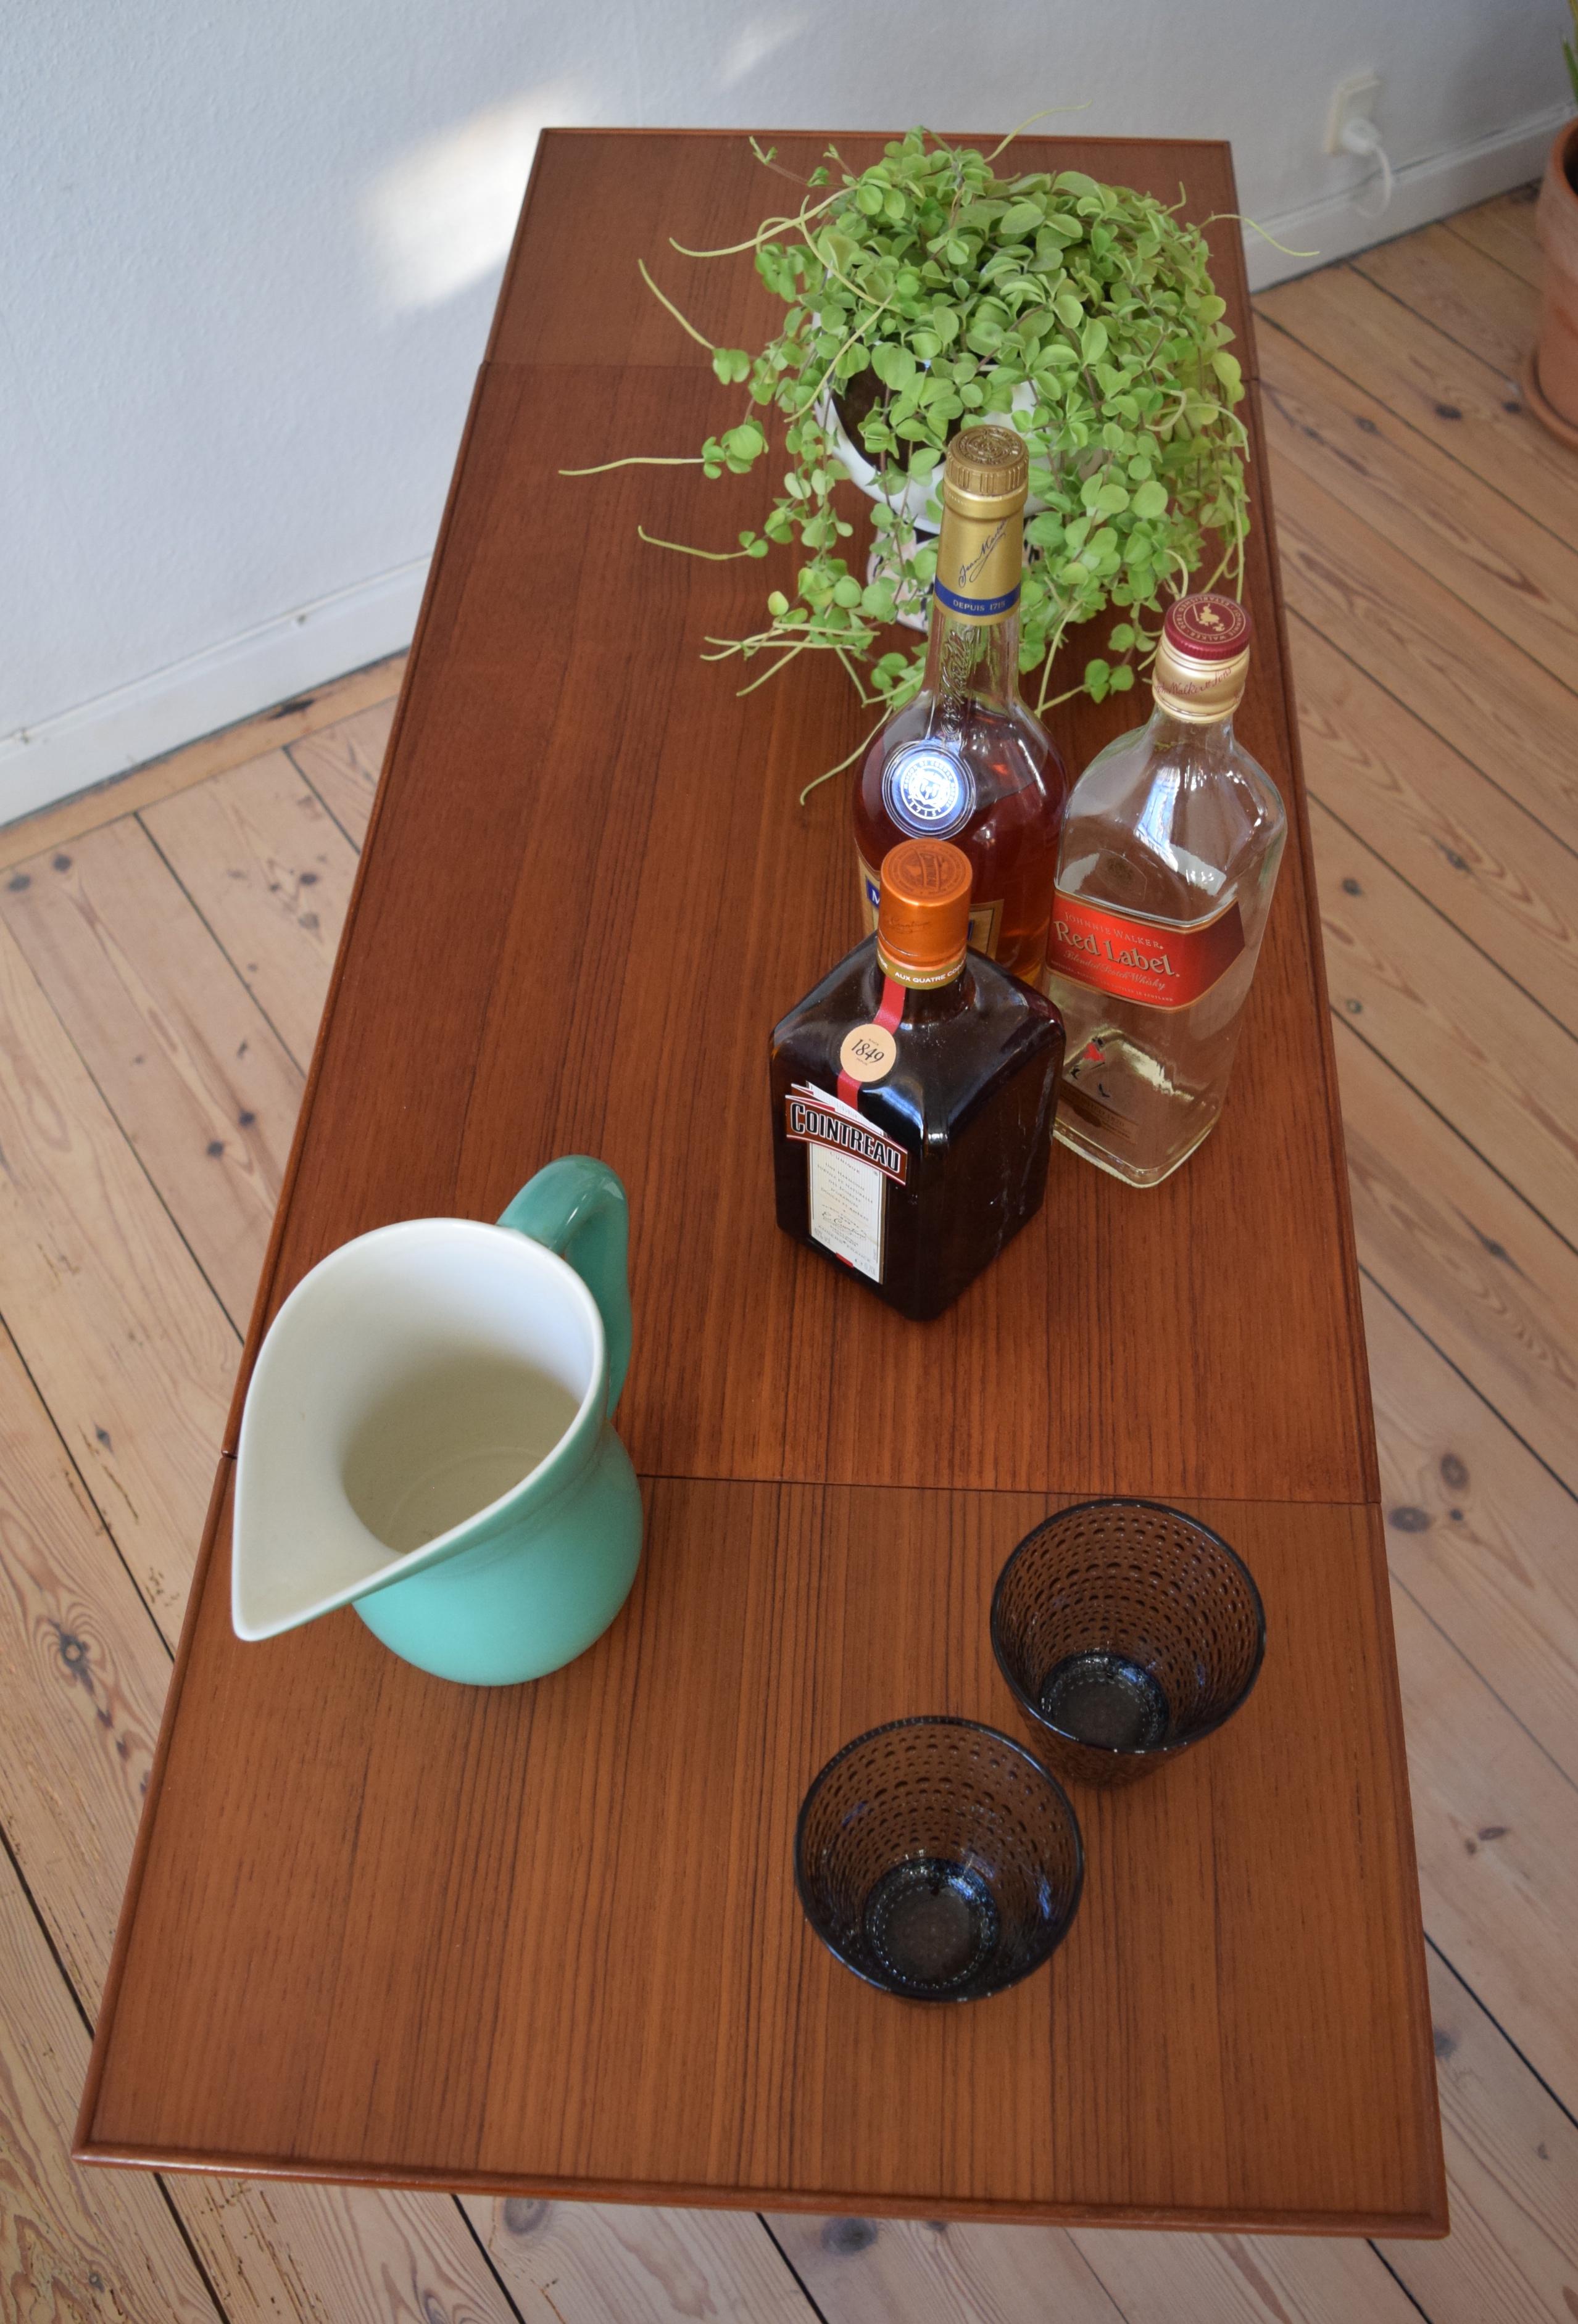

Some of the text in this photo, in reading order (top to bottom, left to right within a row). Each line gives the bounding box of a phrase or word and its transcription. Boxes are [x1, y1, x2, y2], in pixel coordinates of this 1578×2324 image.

[953, 599, 1005, 611] DEPUIS 1715
[1189, 609, 1242, 641] JOHNNIE WALKER
[1173, 682, 1203, 695] Walker
[1065, 912, 1159, 949] JOHNNIE WALKER
[1053, 920, 1100, 956] Red
[1103, 940, 1174, 976] Label
[895, 959, 965, 983] AUX QUATRE COIN
[1064, 951, 1101, 970] Blended
[1101, 962, 1131, 980] Scotch
[1130, 971, 1166, 991] Whisky
[851, 1039, 884, 1064] 1849
[790, 1102, 901, 1173] COINTREAU
